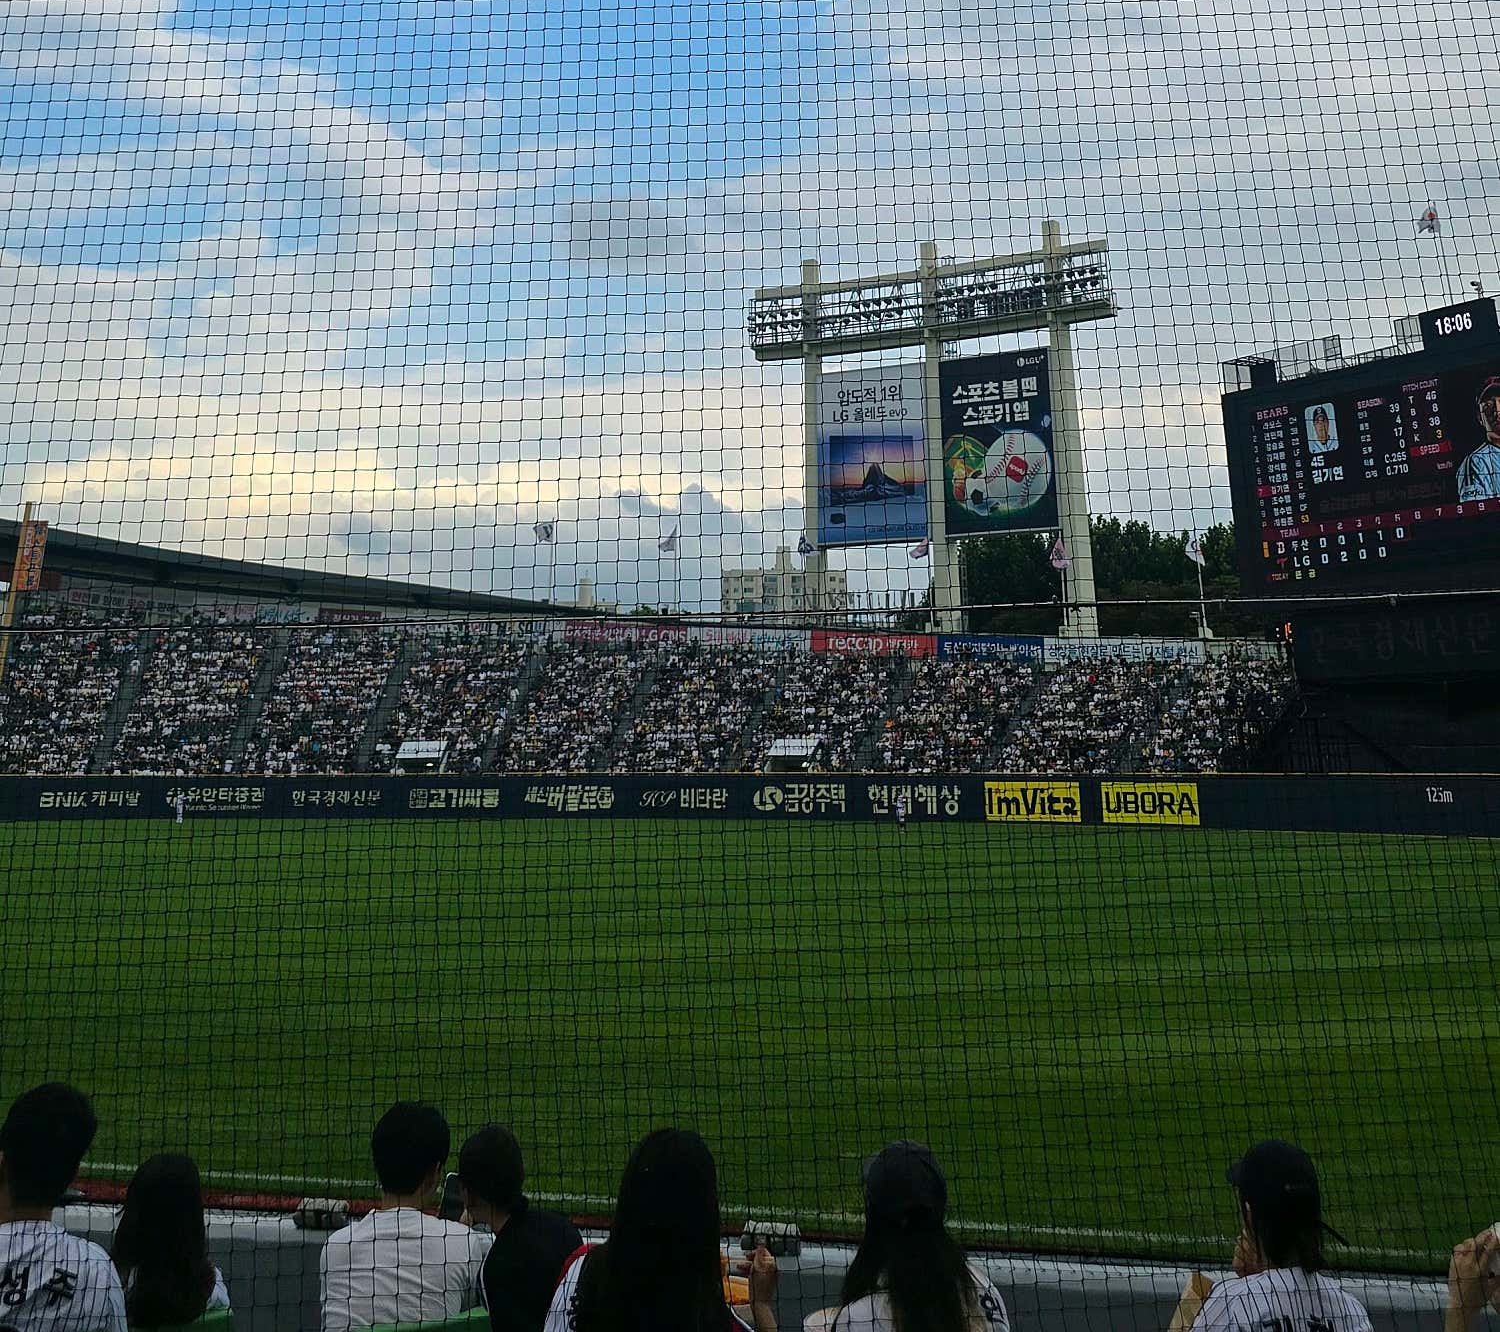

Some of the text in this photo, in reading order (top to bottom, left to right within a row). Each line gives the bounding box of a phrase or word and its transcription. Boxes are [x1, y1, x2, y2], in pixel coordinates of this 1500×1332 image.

[1434, 312, 1473, 336] 18:06
[1419, 378, 1439, 389] COUNT
[838, 384, 902, 407] 압도적 1위
[952, 381, 1000, 405] 스포츠
[1408, 390, 1437, 404] T 46
[1356, 397, 1383, 410] SEASON
[1389, 403, 1400, 413] 39
[1432, 403, 1439, 412] 8
[833, 406, 907, 422] LG 올레드 evo
[962, 400, 1030, 427] 스포키 앱
[1256, 406, 1289, 421] BEARS
[1395, 415, 1401, 424] 4
[1412, 416, 1441, 429] S 38
[1393, 427, 1403, 437] 17
[1414, 429, 1443, 442] K 3
[1399, 439, 1406, 448] 0
[1419, 444, 1440, 455] SPEED
[1310, 455, 1325, 467] 45
[1311, 465, 1344, 485] 김기연
[1386, 464, 1409, 476] 0.710
[1279, 527, 1300, 538] TEAM
[1336, 522, 1344, 531] 2
[1355, 519, 1362, 527] 3
[1435, 508, 1443, 517] 7
[1478, 502, 1485, 511] 9
[1300, 514, 1310, 523] 53
[1291, 539, 1309, 552] 두산
[1319, 537, 1327, 548] 0
[1337, 534, 1346, 545] 0
[1358, 532, 1364, 543] 1
[1377, 530, 1383, 541] 1
[1395, 527, 1404, 539] 0
[1293, 555, 1311, 568] LG
[1321, 553, 1329, 564] 0
[1340, 551, 1349, 562] 2
[1358, 548, 1367, 560] 0
[1378, 546, 1387, 558] 0
[1048, 644, 1079, 658] 상상을
[1111, 645, 1141, 658] 만드는
[1144, 645, 1174, 659] 디지털
[39, 790, 142, 808] BNK 캐피탈
[186, 787, 266, 803] 유안타증권
[292, 789, 382, 808] 한국경제신문
[680, 788, 728, 809] 비타란
[784, 783, 846, 813] 금강주택
[867, 784, 961, 816] 현대해상
[1424, 786, 1453, 803] 125m
[1105, 791, 1198, 816] UBORA
